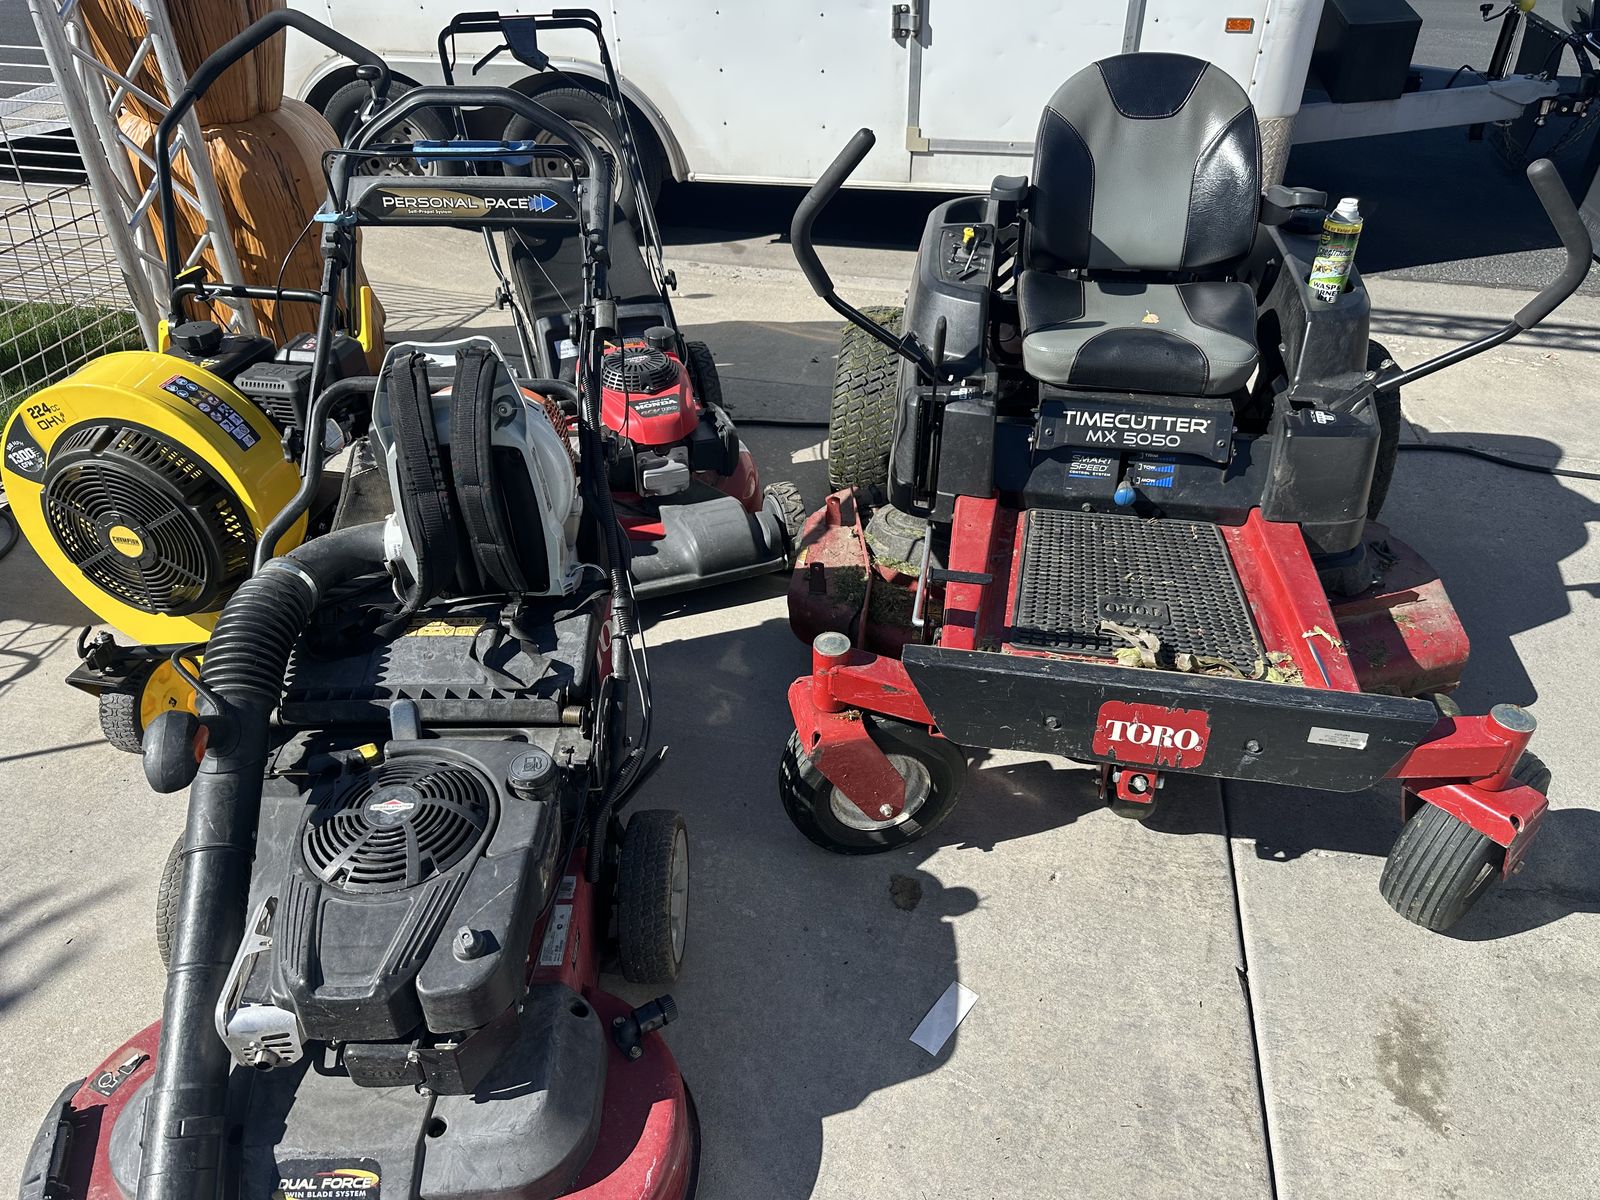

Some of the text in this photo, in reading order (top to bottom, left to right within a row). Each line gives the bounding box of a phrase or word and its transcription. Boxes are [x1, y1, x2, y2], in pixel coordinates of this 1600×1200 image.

[382, 197, 529, 209] PERSONAL PACE
[1313, 281, 1337, 291] WASP
[635, 400, 678, 411] HONDA
[1063, 410, 1208, 434] TIMECUTTER
[1085, 429, 1181, 447] MX 5050
[8, 447, 36, 464] 1300
[1072, 455, 1112, 464] SMART
[1070, 462, 1107, 472] SPEED
[1105, 719, 1200, 750] TORO
[278, 1178, 372, 1190] DUAL FORCE
